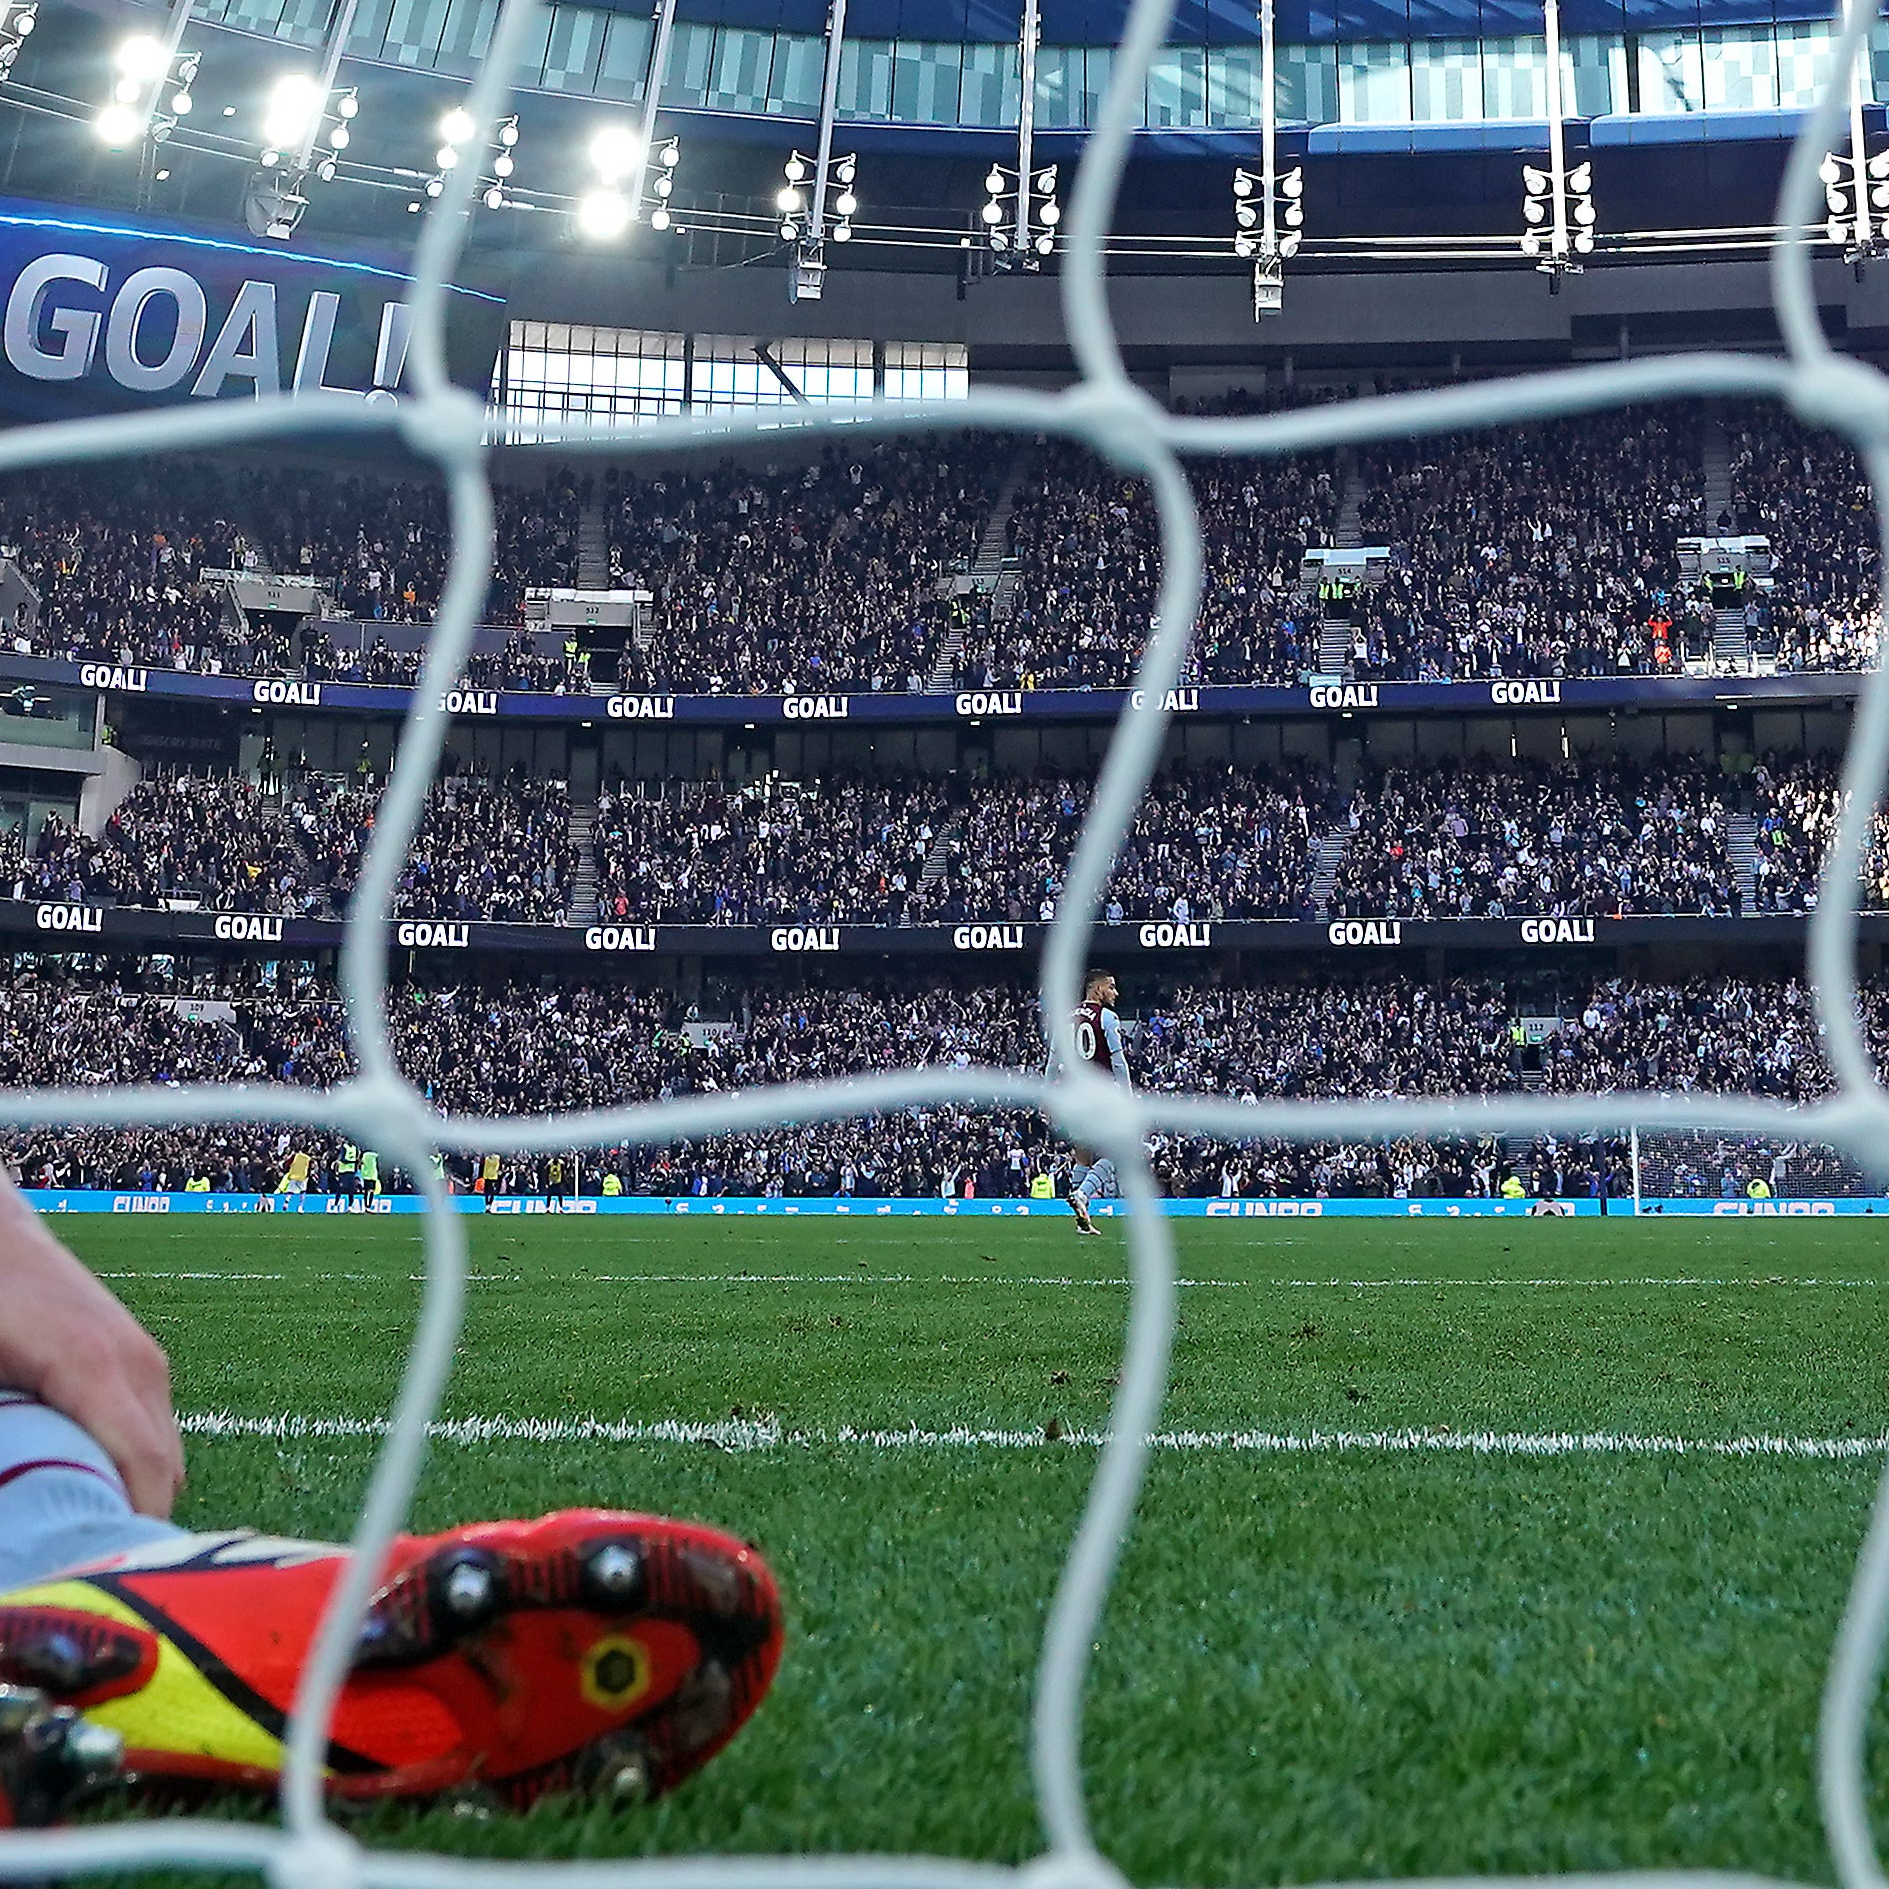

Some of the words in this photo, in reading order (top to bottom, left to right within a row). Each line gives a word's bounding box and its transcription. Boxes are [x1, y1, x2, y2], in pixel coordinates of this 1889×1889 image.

[3, 253, 416, 413] GOAL!
[81, 663, 147, 692] GOAL!
[254, 680, 320, 706] GOAL!
[956, 692, 1022, 715] GOAL!
[1310, 685, 1379, 709] GOAL!
[1492, 680, 1560, 705] GOAL!
[607, 696, 673, 719] GOAL!
[783, 696, 847, 719] GOAL!
[37, 906, 102, 932] GOAL!
[215, 916, 282, 941] GOAL!
[1521, 918, 1594, 942] GOAL!
[398, 923, 469, 947] GOAL!
[586, 927, 655, 951] GOAL!
[772, 928, 840, 951] GOAL!
[953, 926, 1023, 949] GOAL!
[1140, 924, 1210, 947] GOAL!
[1329, 921, 1400, 945] GOAL!
